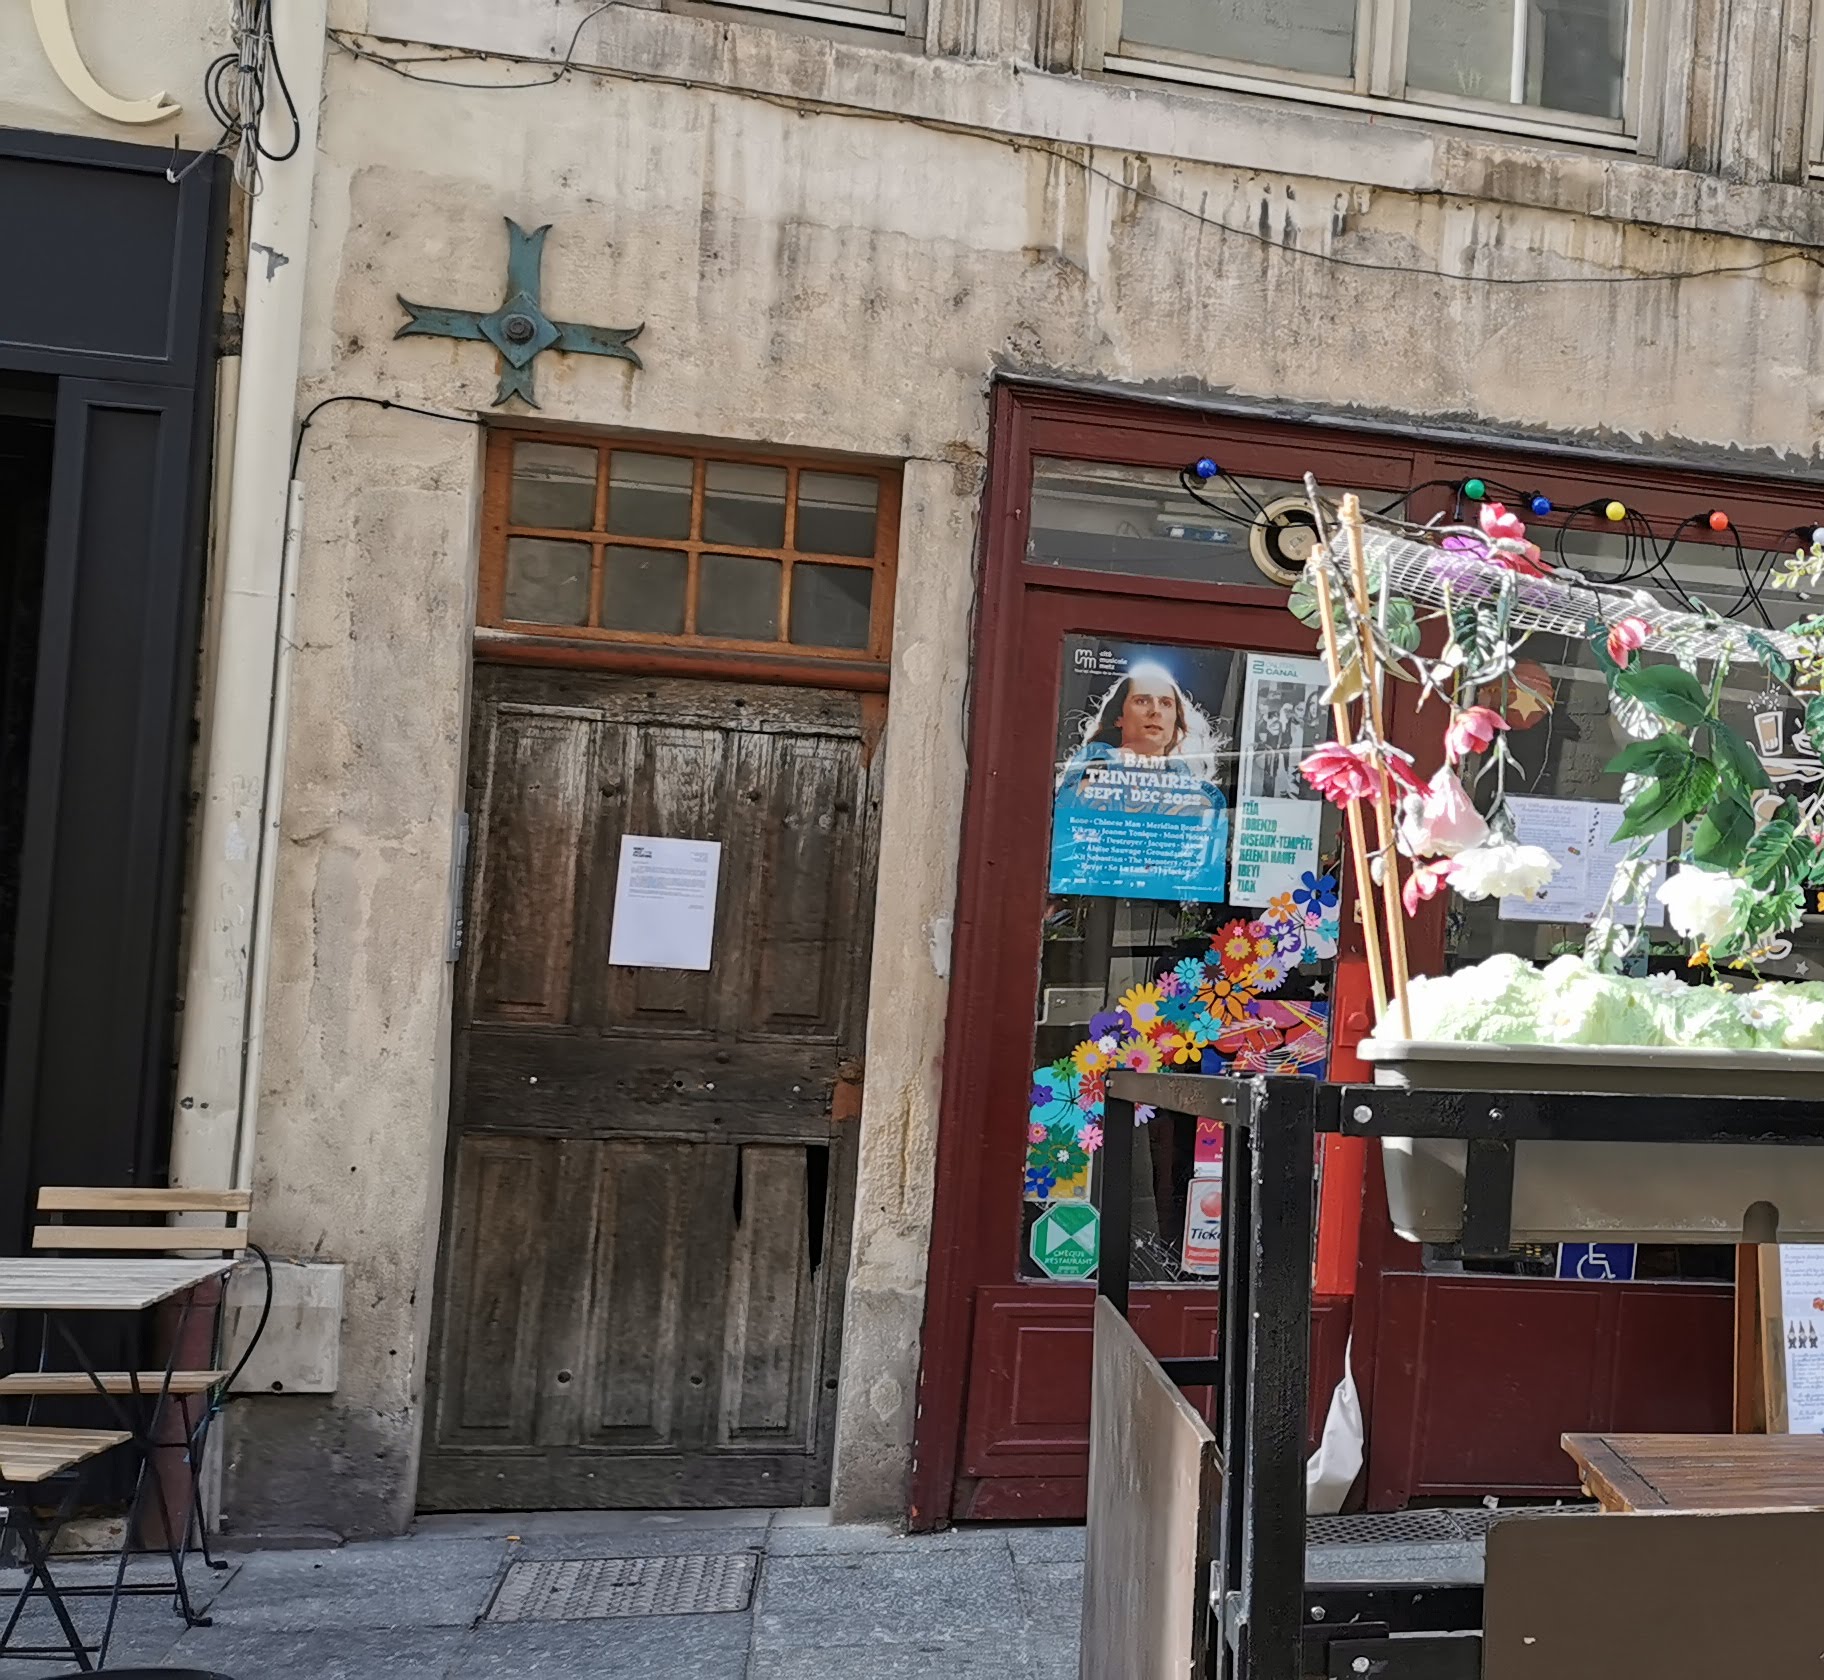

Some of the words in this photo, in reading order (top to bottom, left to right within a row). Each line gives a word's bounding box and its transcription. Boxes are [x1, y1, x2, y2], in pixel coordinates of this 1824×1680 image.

[1266, 668, 1298, 677] CANAL
[1124, 753, 1167, 770] BAM
[1086, 769, 1202, 791] TRINITAIRES
[1084, 787, 1123, 800] SEPT
[1131, 787, 1161, 803] DÉC
[1163, 793, 1202, 806] 2022
[1093, 818, 1123, 826] Chinese
[1124, 820, 1142, 828] Man
[1147, 822, 1179, 830] Meridian
[1241, 817, 1277, 832] LORENZO
[1107, 837, 1143, 847] Destroyer
[1146, 840, 1176, 849] Jacques
[1110, 846, 1141, 856] Sauvage
[1239, 848, 1269, 863] HELENA
[1270, 851, 1297, 865] HAUFF
[1087, 853, 1123, 862] Sebastian
[1128, 856, 1143, 864] The
[1044, 1257, 1093, 1265] RESTAURANT
